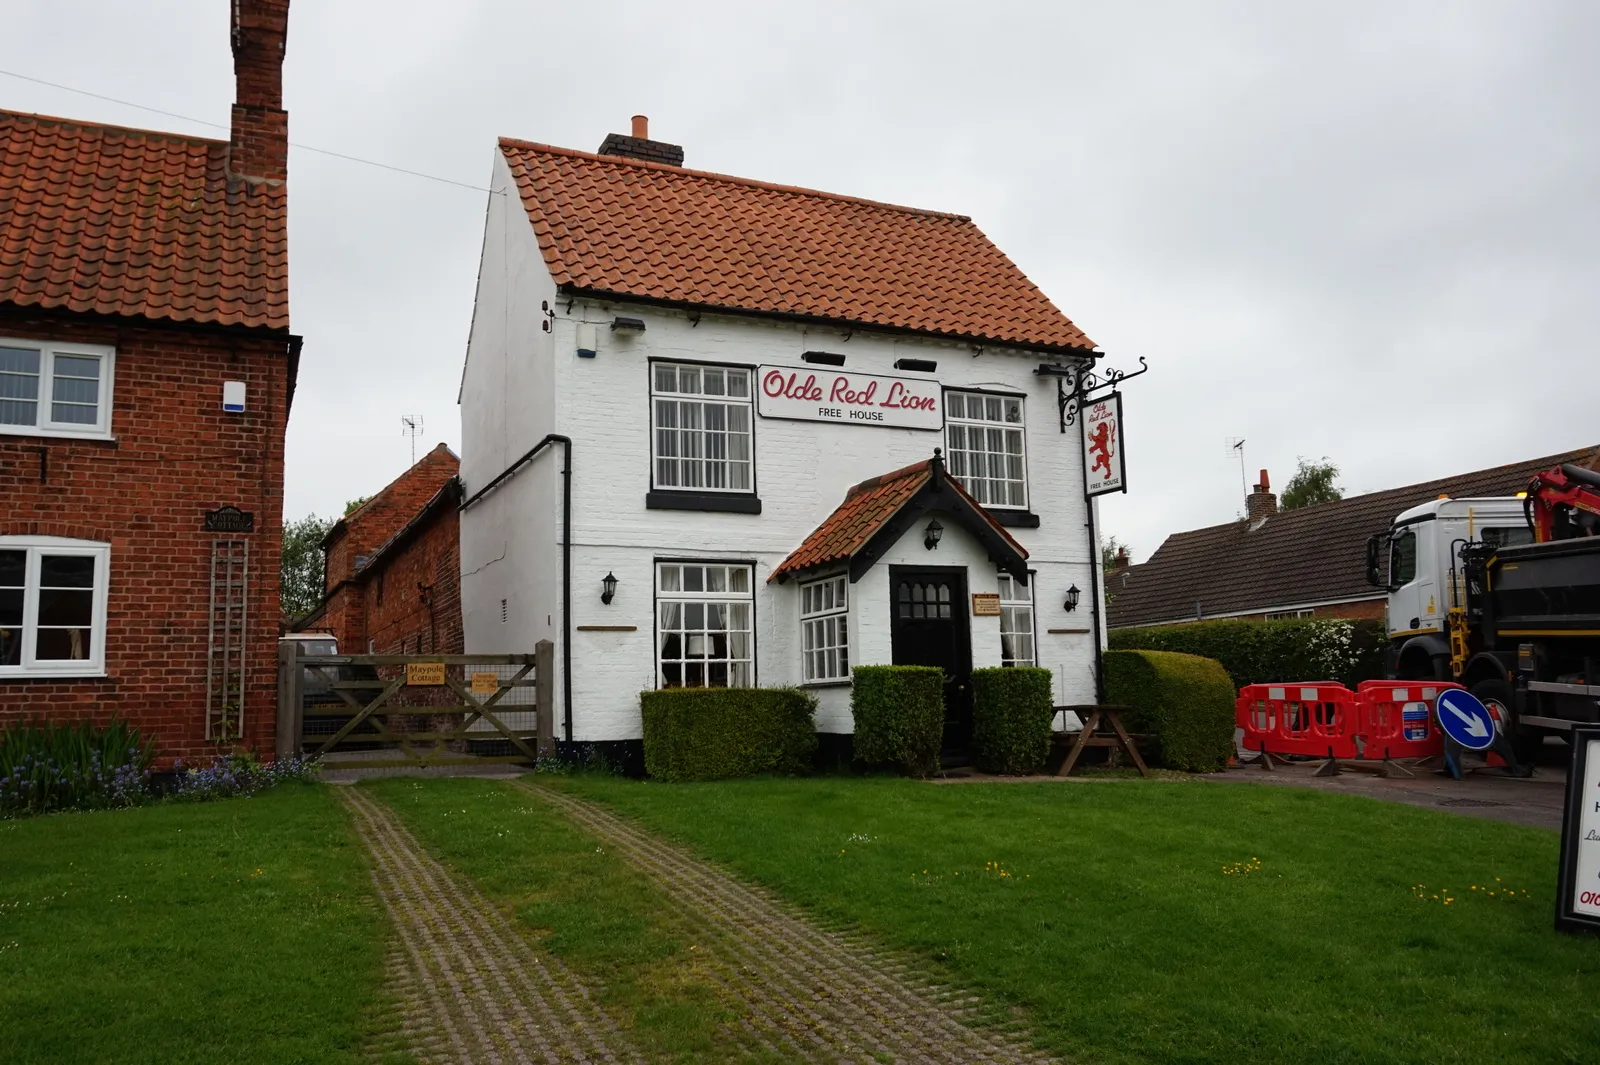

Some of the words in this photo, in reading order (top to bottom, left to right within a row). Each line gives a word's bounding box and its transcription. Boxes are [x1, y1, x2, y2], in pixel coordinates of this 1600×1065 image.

[763, 370, 823, 401] Olde
[829, 376, 877, 405] Red
[879, 381, 936, 412] Lion
[1093, 402, 1106, 413] Olde
[818, 407, 842, 418] FREE
[849, 410, 884, 421] HOUSE
[1088, 411, 1100, 423] Red
[1100, 409, 1113, 419] Lion
[1103, 478, 1119, 487] HOUSE
[409, 665, 444, 674] Maypole
